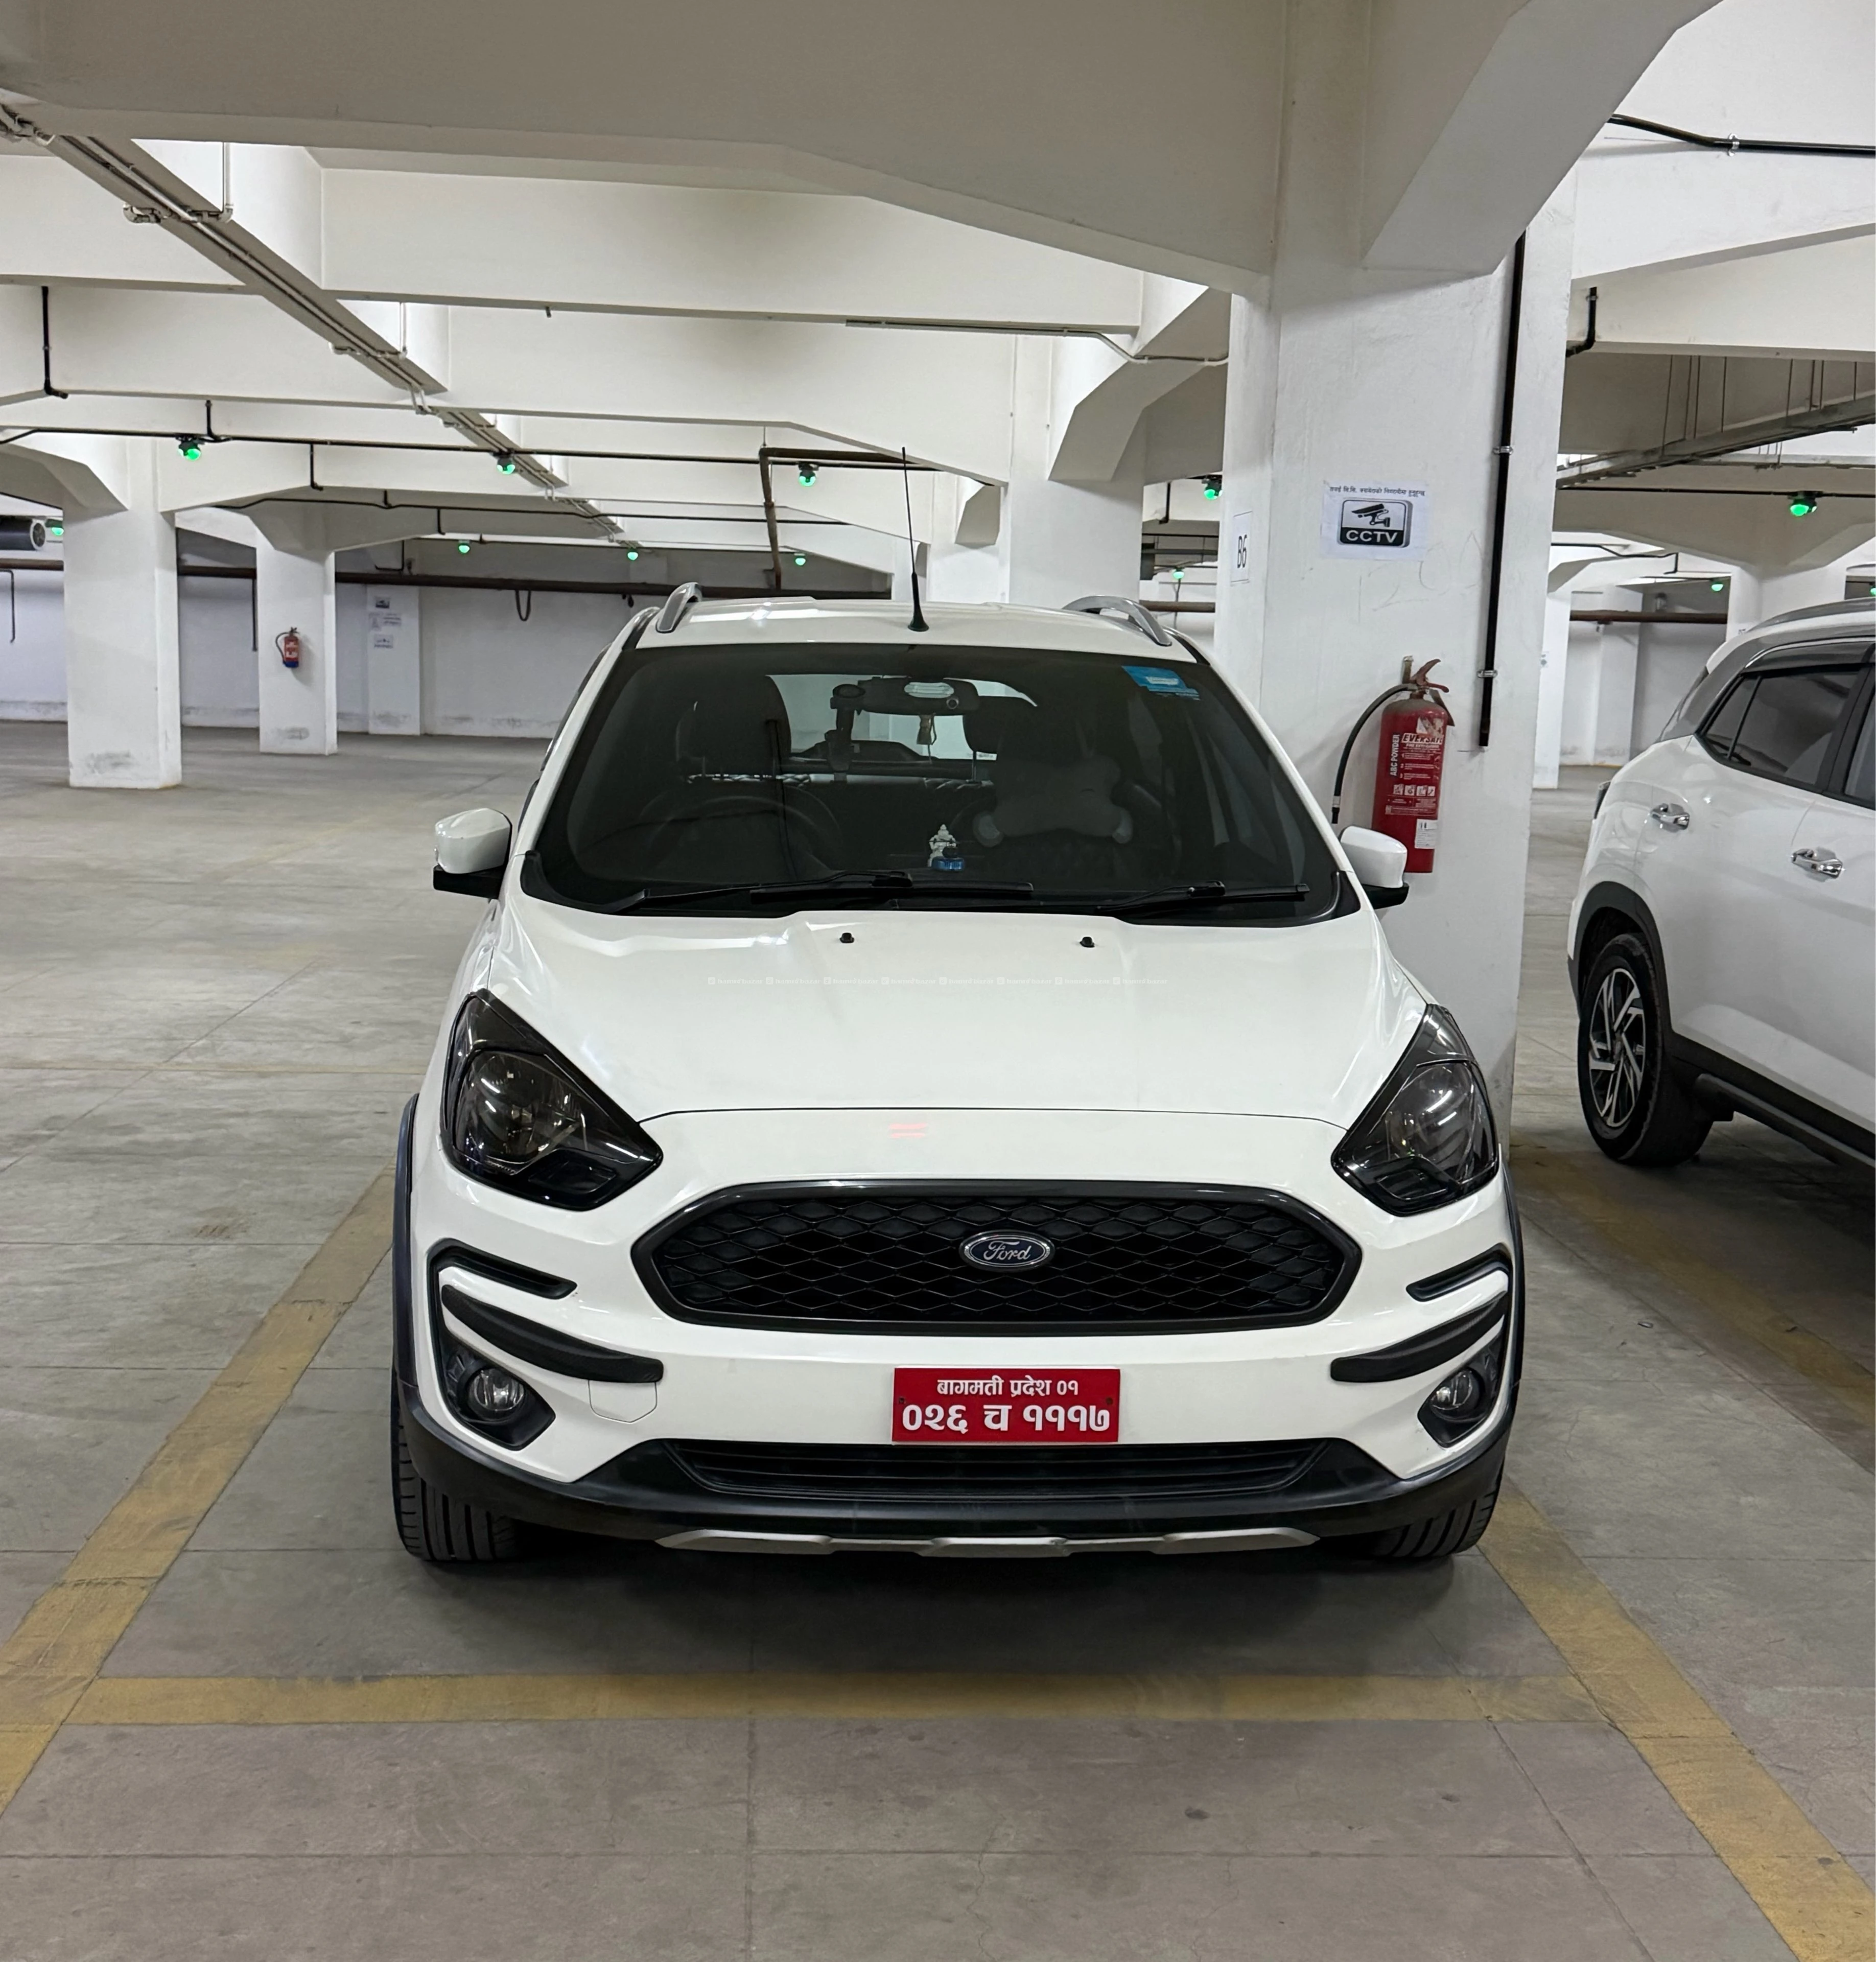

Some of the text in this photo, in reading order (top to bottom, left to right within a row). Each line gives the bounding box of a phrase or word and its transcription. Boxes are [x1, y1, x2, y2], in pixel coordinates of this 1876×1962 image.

[1346, 529, 1398, 543] CCTV
[1237, 534, 1248, 569] B6
[1390, 734, 1400, 776] ABC POWDER
[983, 1240, 1032, 1260] Ford
[937, 1374, 1078, 1397] बागमती प्रदेश ०१
[902, 1404, 1110, 1434] ०२६ च १११७
